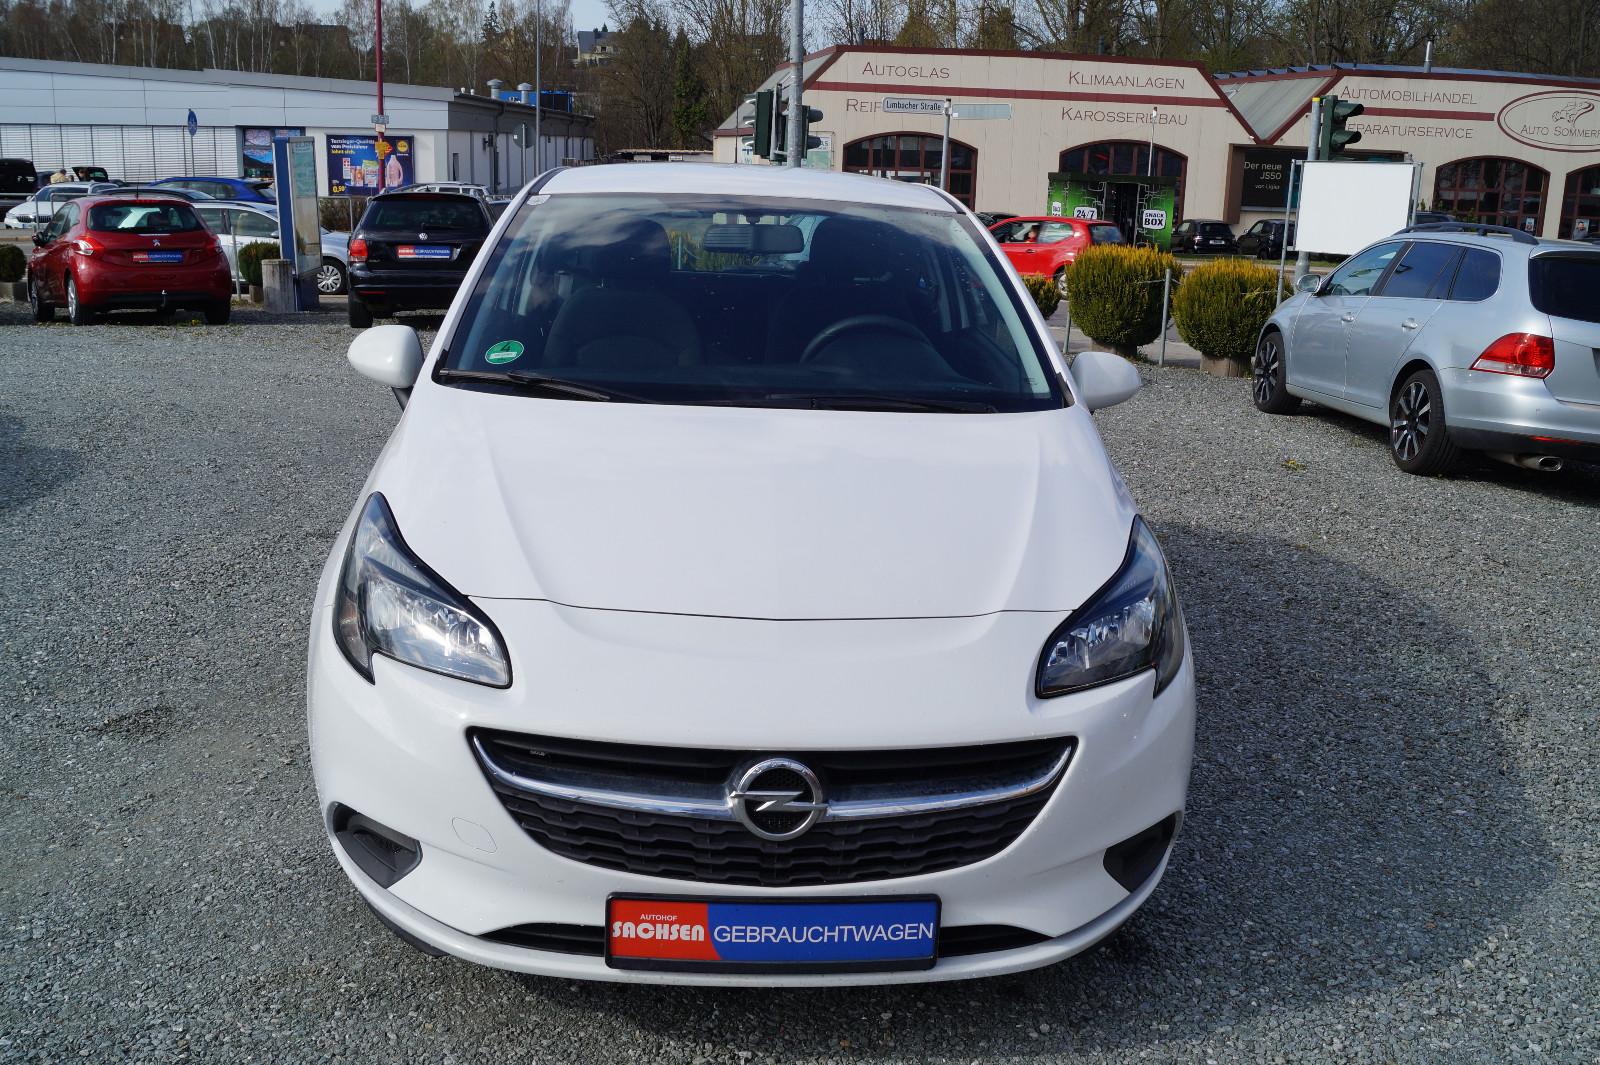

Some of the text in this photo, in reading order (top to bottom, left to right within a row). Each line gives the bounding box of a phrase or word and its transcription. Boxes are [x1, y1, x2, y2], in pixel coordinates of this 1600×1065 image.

[862, 61, 950, 79] AUTOGLAS
[1068, 71, 1185, 89] KLIMAANLAGEN
[1340, 86, 1477, 105] AUTOMOBILHANDEL
[846, 98, 882, 113] REIF
[886, 100, 942, 111] Limbacher Straße
[1061, 107, 1188, 126] KAROSSERIEBAU
[1346, 123, 1474, 139] EPARATURSERVICE
[1520, 125, 1549, 136] AUTO
[1244, 161, 1259, 170] Der
[1076, 209, 1096, 219] 24/7
[1144, 218, 1164, 226] BOX
[500, 341, 511, 352] 4
[640, 913, 678, 922] AUTOHOF
[612, 921, 934, 944] SACHSEN GEBRAUCHTWAGEN
